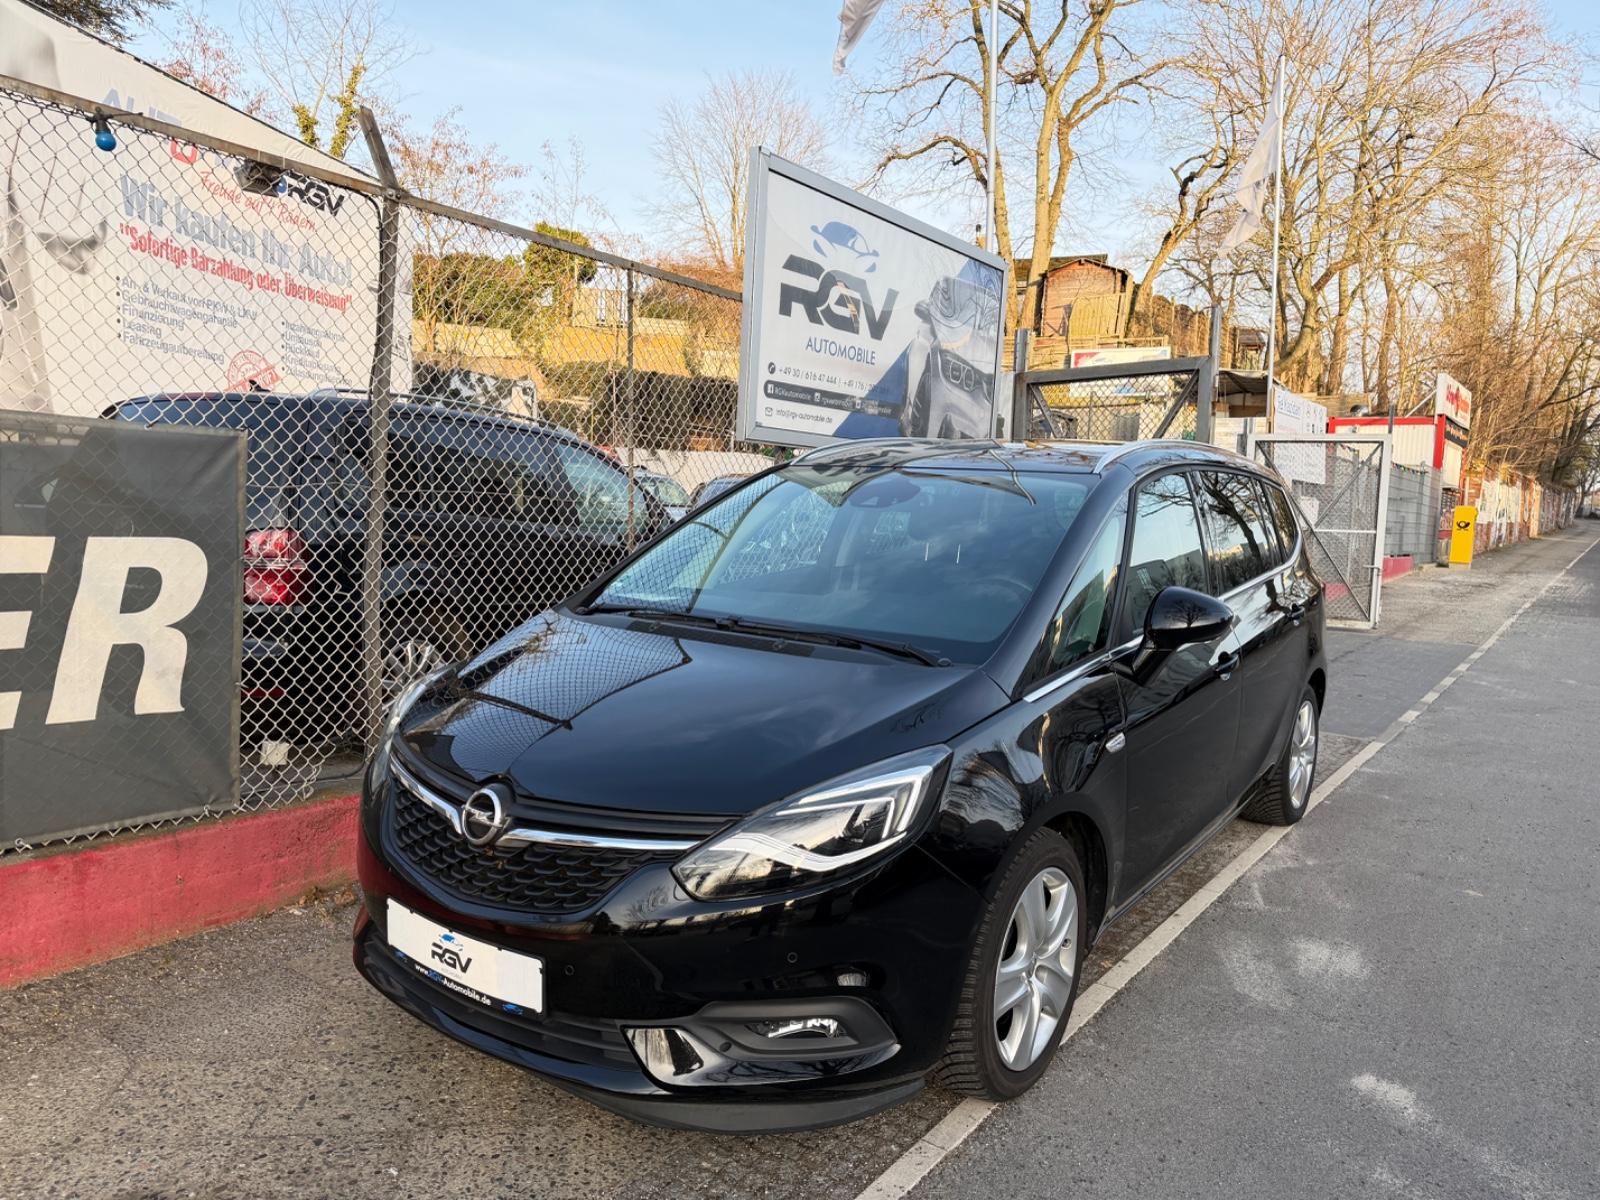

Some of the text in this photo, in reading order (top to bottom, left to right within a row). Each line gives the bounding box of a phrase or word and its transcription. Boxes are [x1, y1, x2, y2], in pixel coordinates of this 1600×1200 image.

[201, 170, 240, 204] Freude
[285, 170, 344, 216] RGV
[120, 173, 352, 288] Wir kaufen Ihr Auto!
[191, 246, 254, 290] Barzahlung
[256, 272, 281, 293] oder
[778, 254, 899, 341] RGV
[805, 336, 876, 366] AUTOMOBILE
[430, 942, 473, 974] RGV
